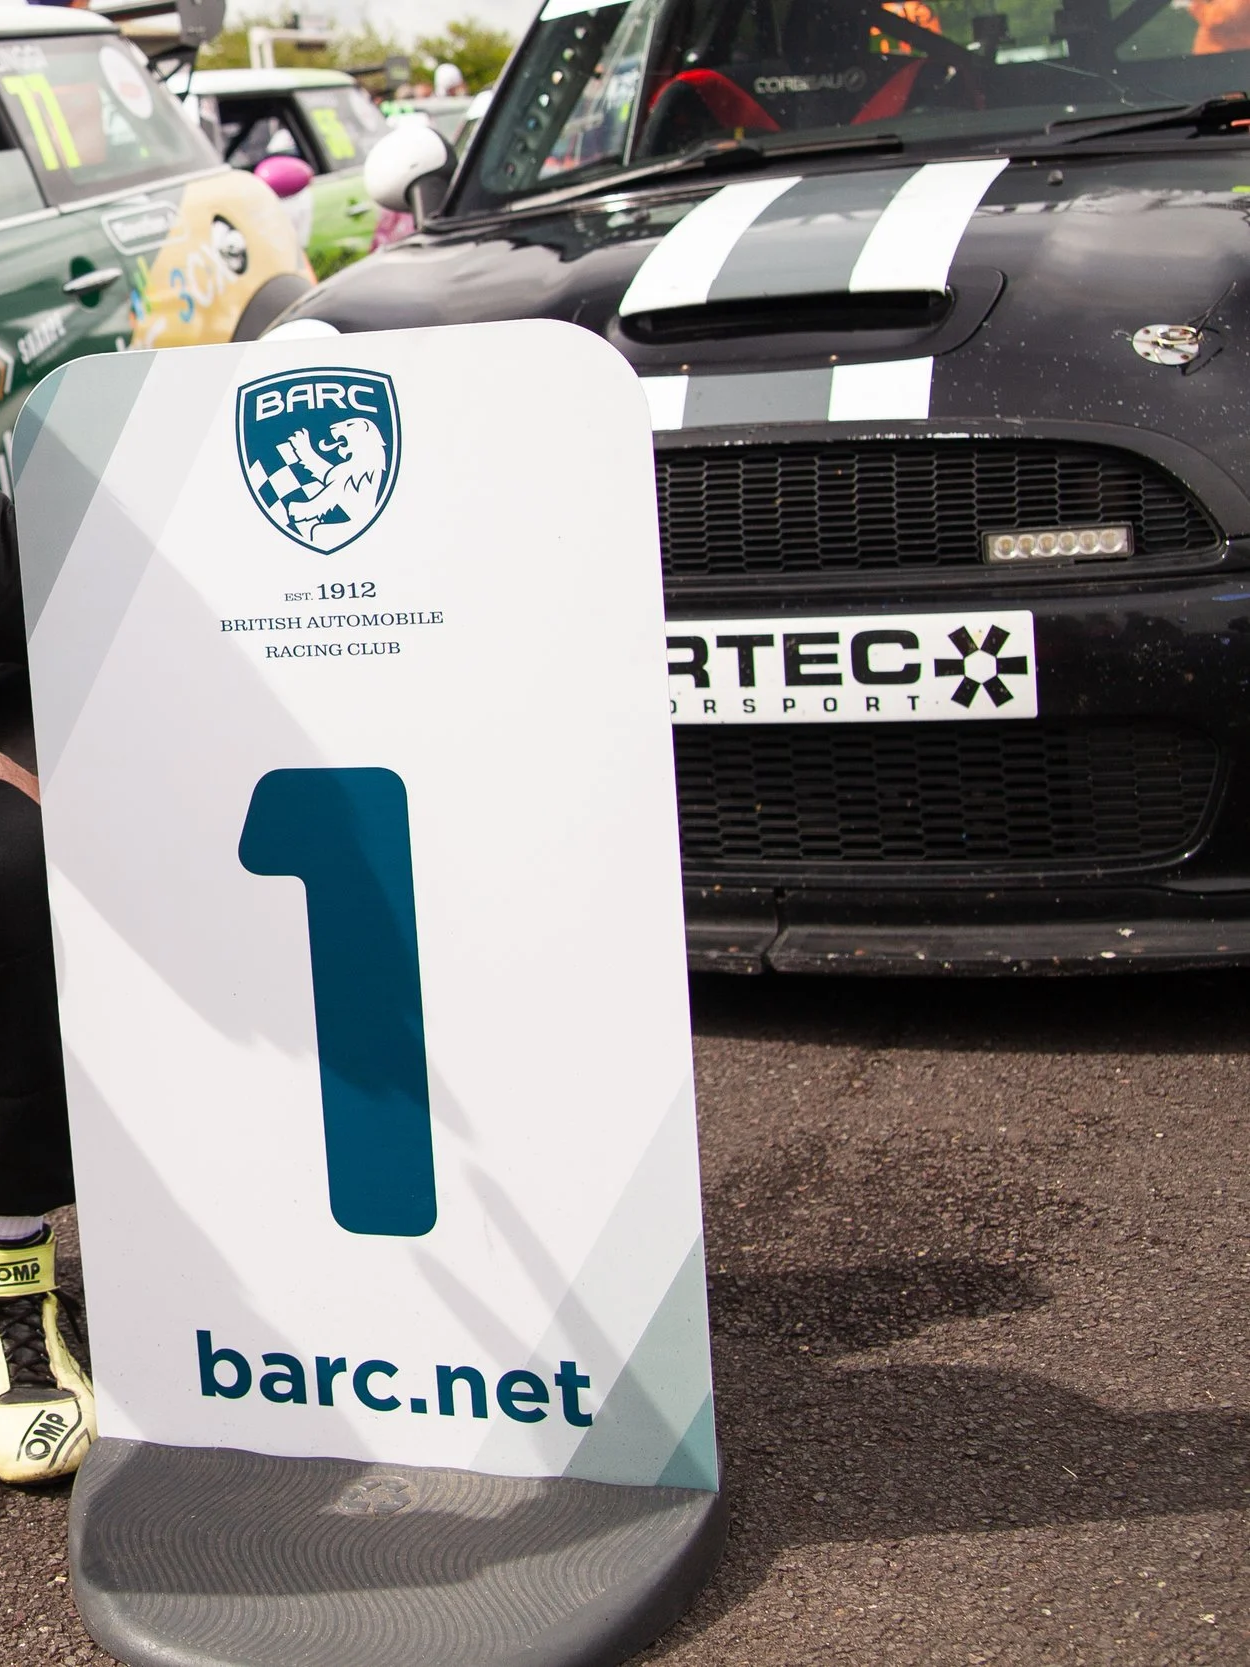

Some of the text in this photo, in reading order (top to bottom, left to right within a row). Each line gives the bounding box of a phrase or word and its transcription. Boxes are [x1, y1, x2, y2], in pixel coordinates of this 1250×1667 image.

[2, 72, 81, 171] 77
[255, 382, 378, 422] BARC
[284, 581, 377, 602] EST. 1912
[220, 611, 444, 632] BRITISH AUTOMOBILE
[265, 641, 401, 659] RACING CLUB
[666, 630, 922, 688] RTEC
[238, 766, 437, 1237] 1
[196, 1329, 593, 1428] barc.net
[25, 1412, 69, 1461] OMP
